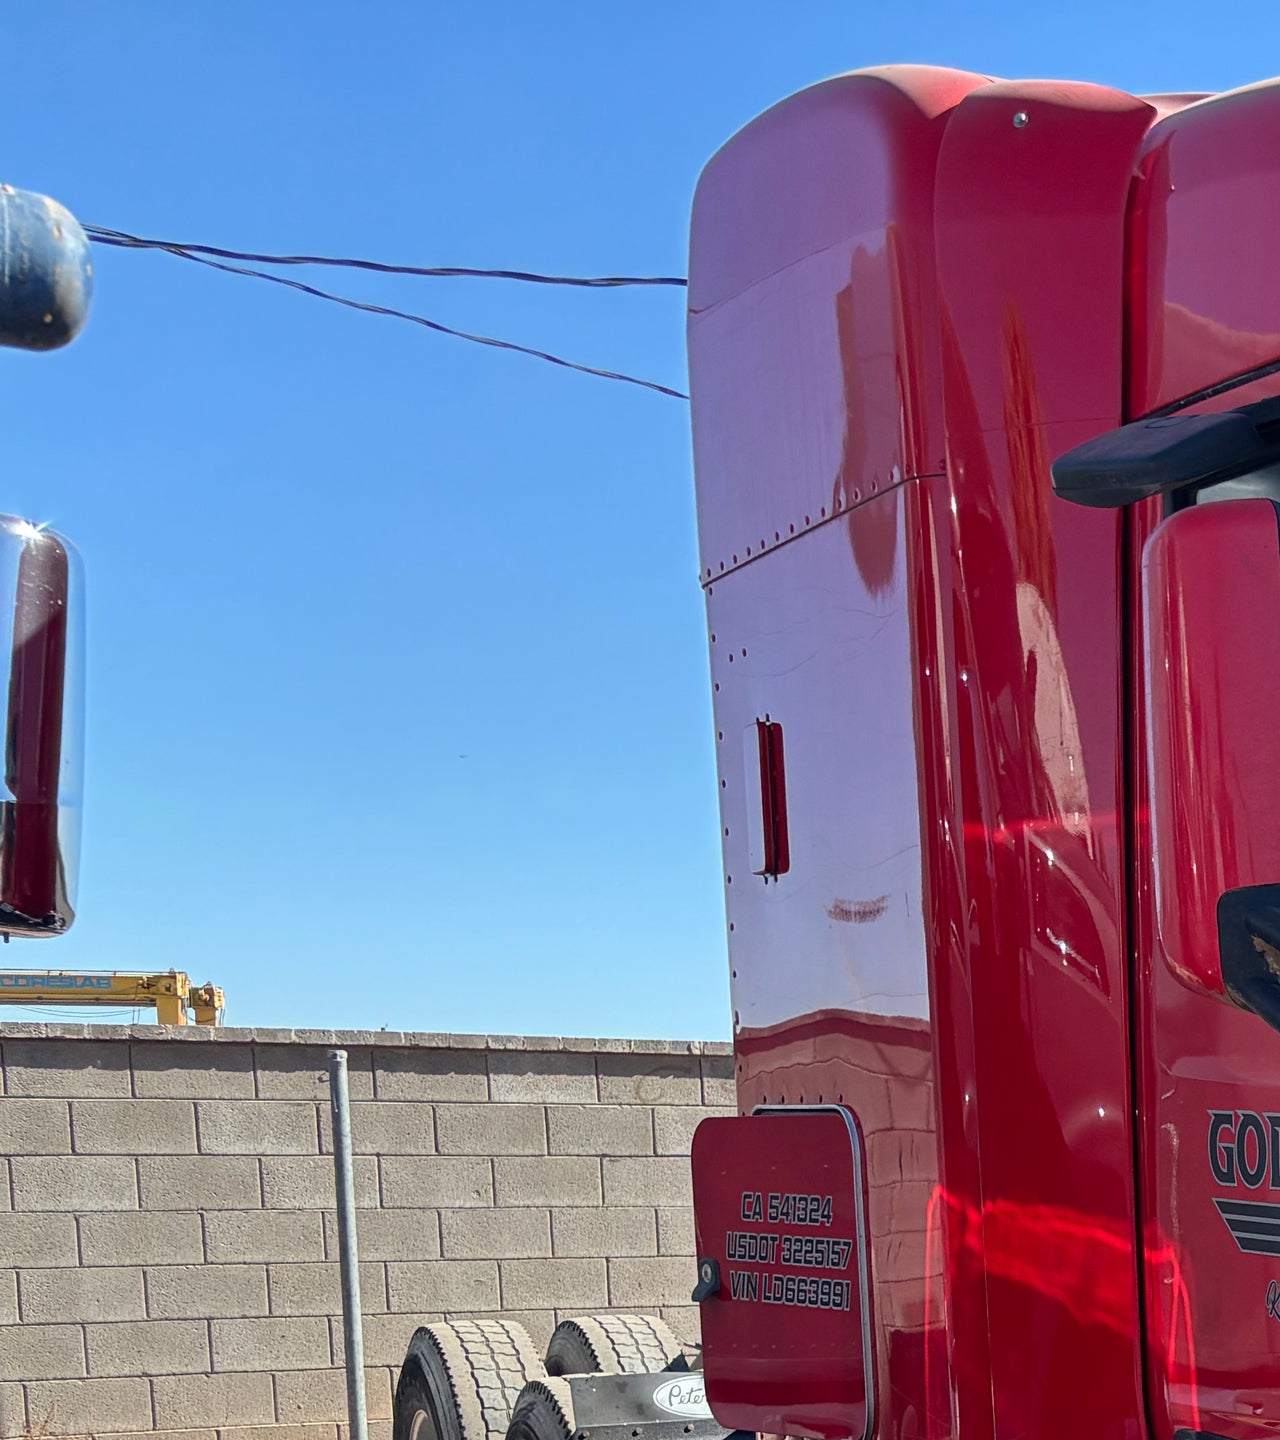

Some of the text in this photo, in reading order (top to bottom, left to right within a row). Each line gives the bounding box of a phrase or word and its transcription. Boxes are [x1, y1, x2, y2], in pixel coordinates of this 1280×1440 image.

[741, 1191, 832, 1226] CA 541324
[726, 1231, 852, 1270] USDOT 3225157
[730, 1270, 851, 1311] VIN LD663991
